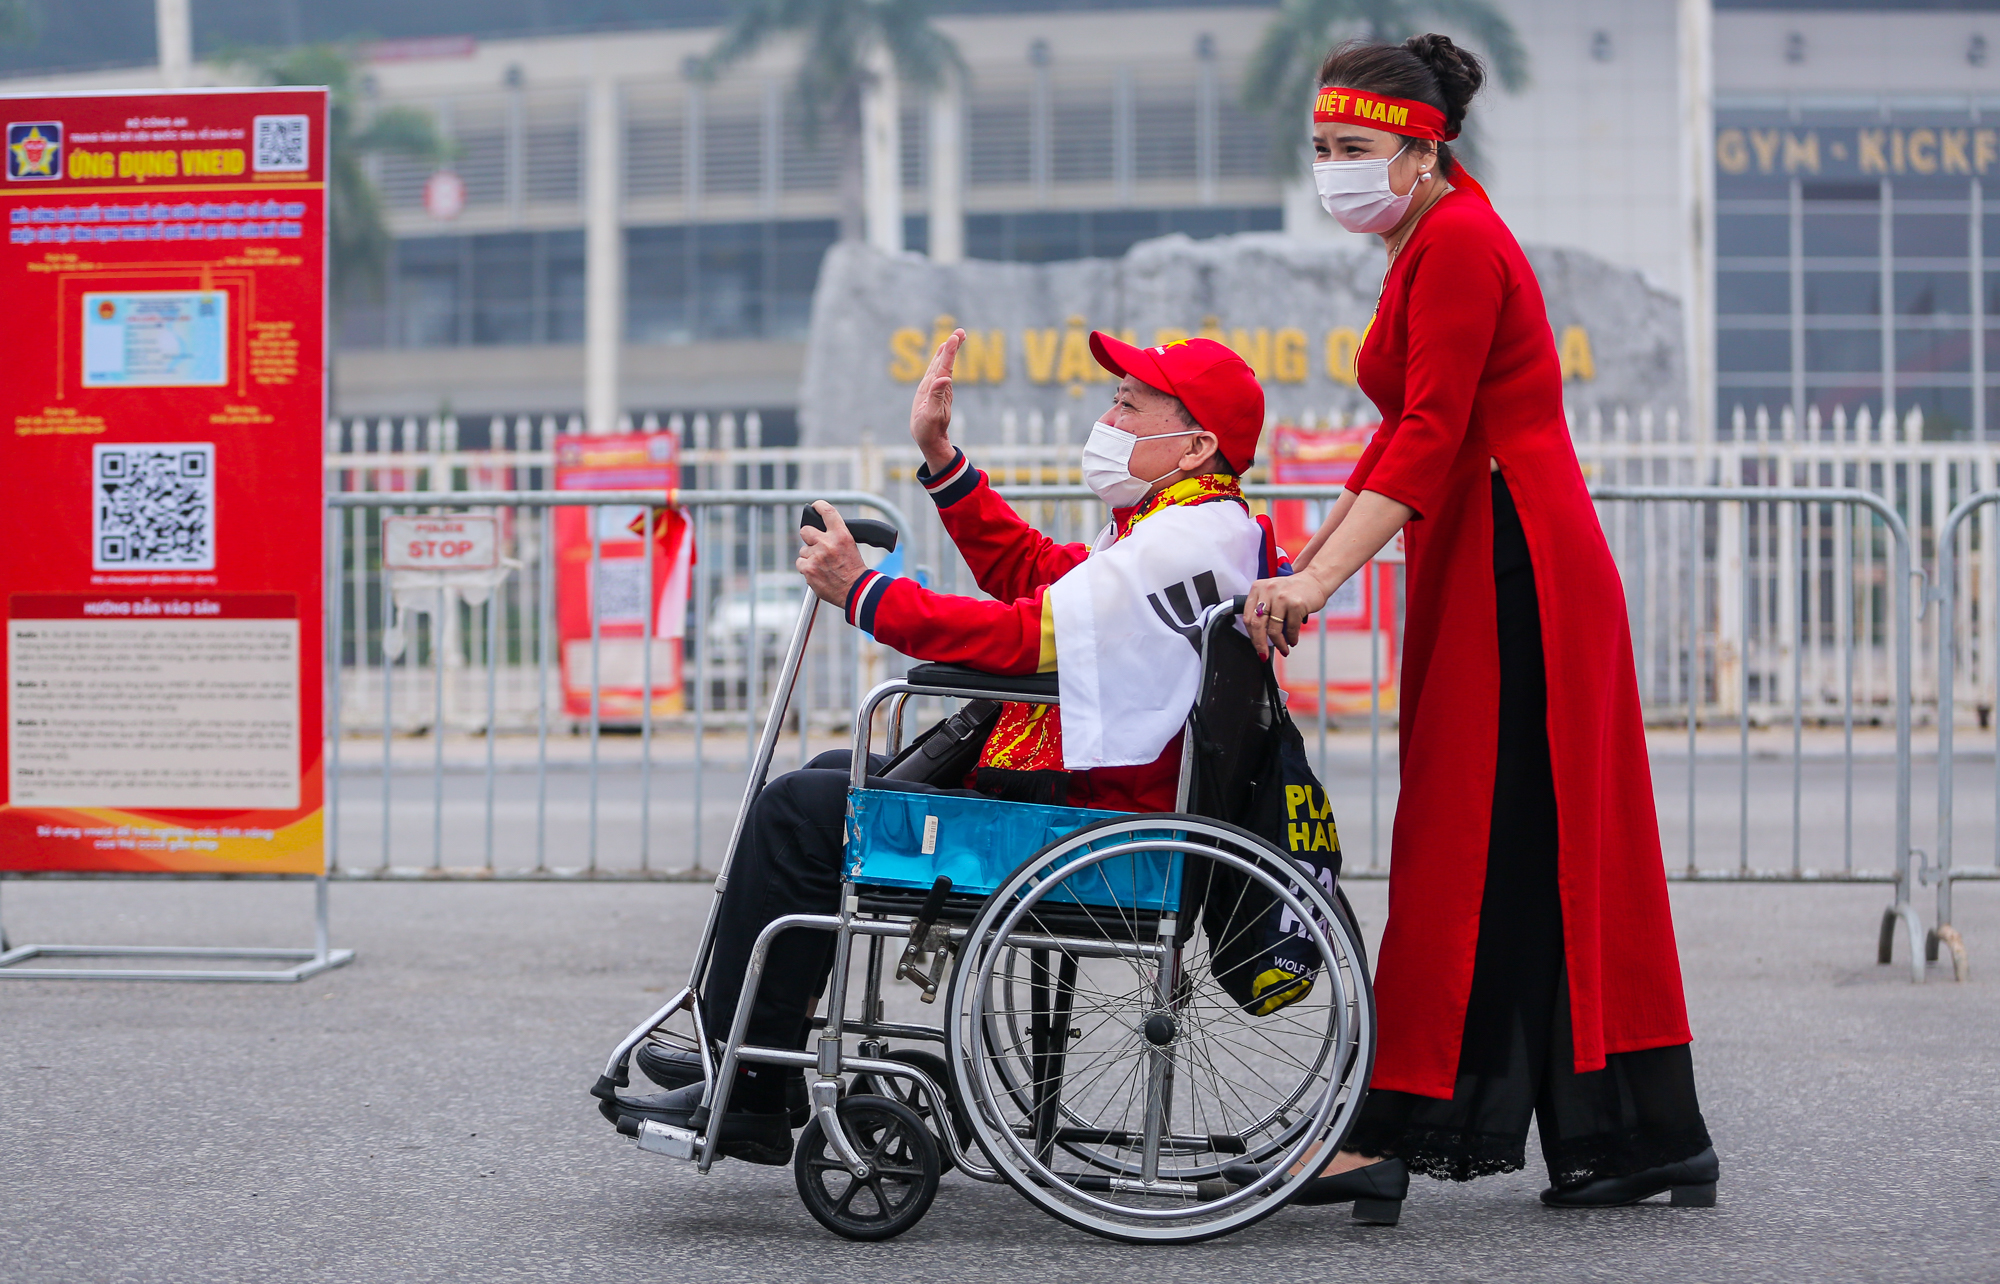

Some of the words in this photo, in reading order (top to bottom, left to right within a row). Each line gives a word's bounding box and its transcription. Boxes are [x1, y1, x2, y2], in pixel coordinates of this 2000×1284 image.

[1315, 90, 1350, 116] VIỆT
[1354, 97, 1409, 126] NAM
[118, 150, 178, 183] DỤNG
[1716, 128, 1822, 175] GYM
[408, 540, 474, 559] STOP
[1274, 956, 1305, 975] WOLF
